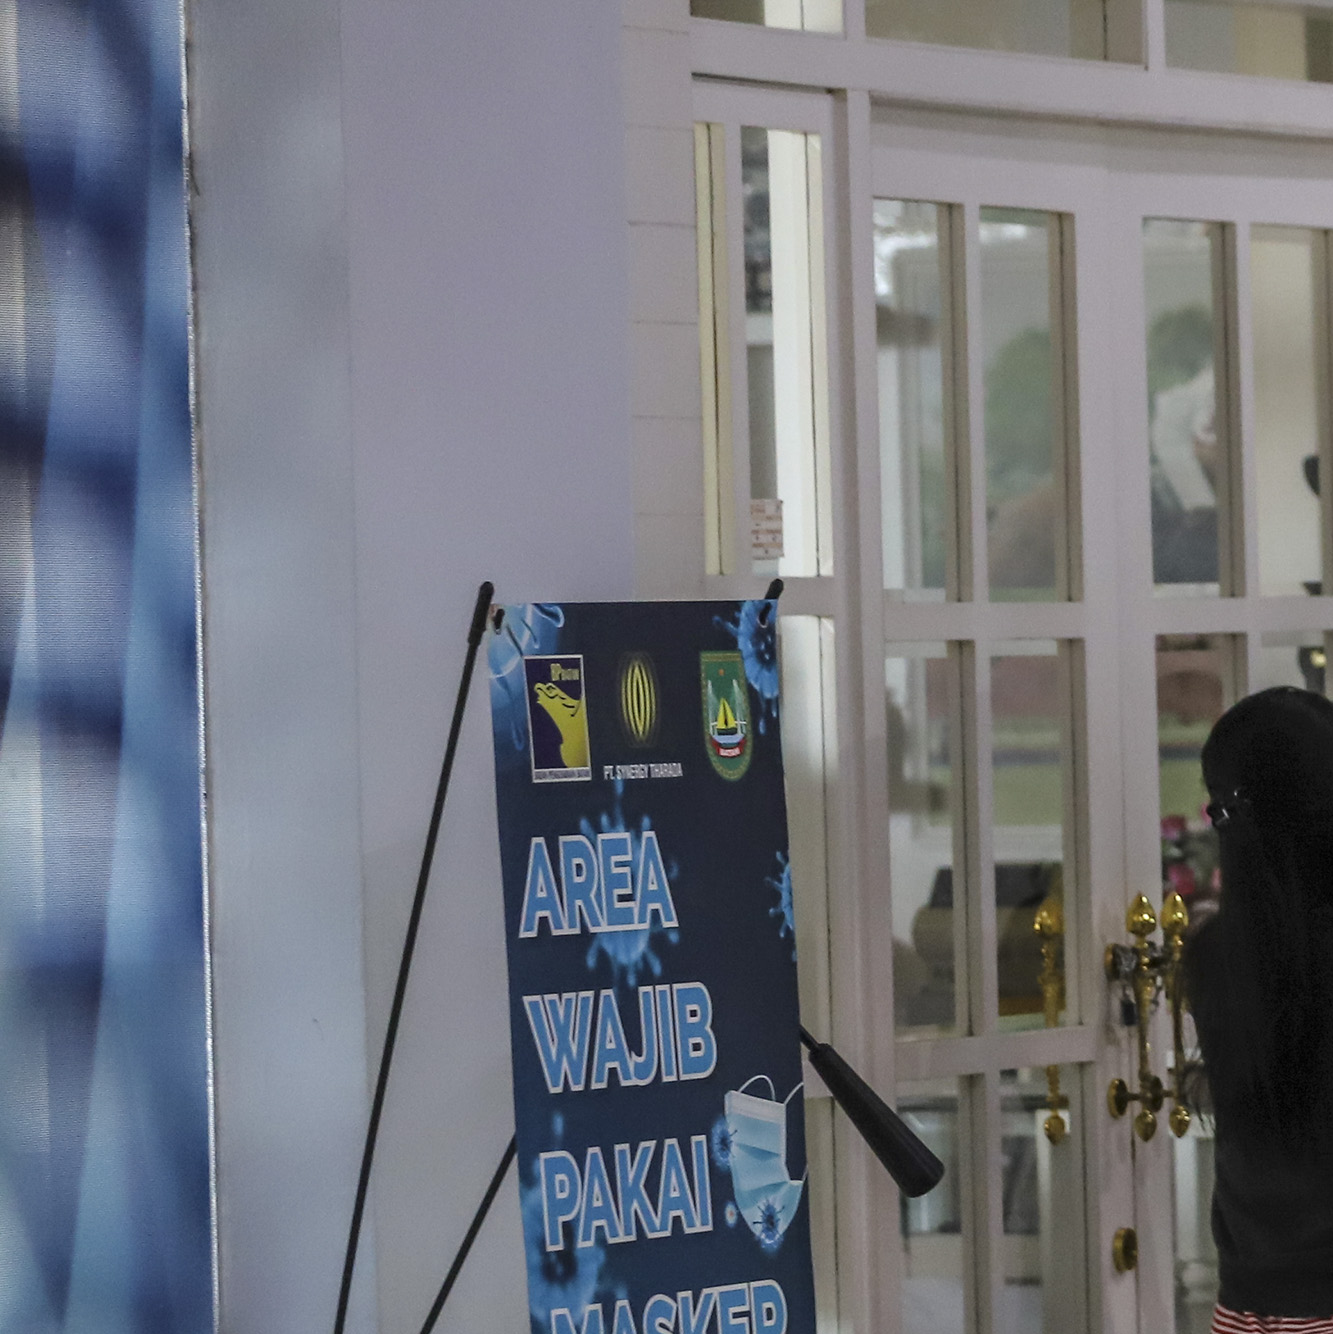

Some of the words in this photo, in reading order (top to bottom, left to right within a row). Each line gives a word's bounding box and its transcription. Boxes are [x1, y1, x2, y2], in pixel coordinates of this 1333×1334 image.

[519, 831, 679, 938] AREA
[522, 981, 717, 1094] WAJIB
[539, 1135, 713, 1252] PAKAI
